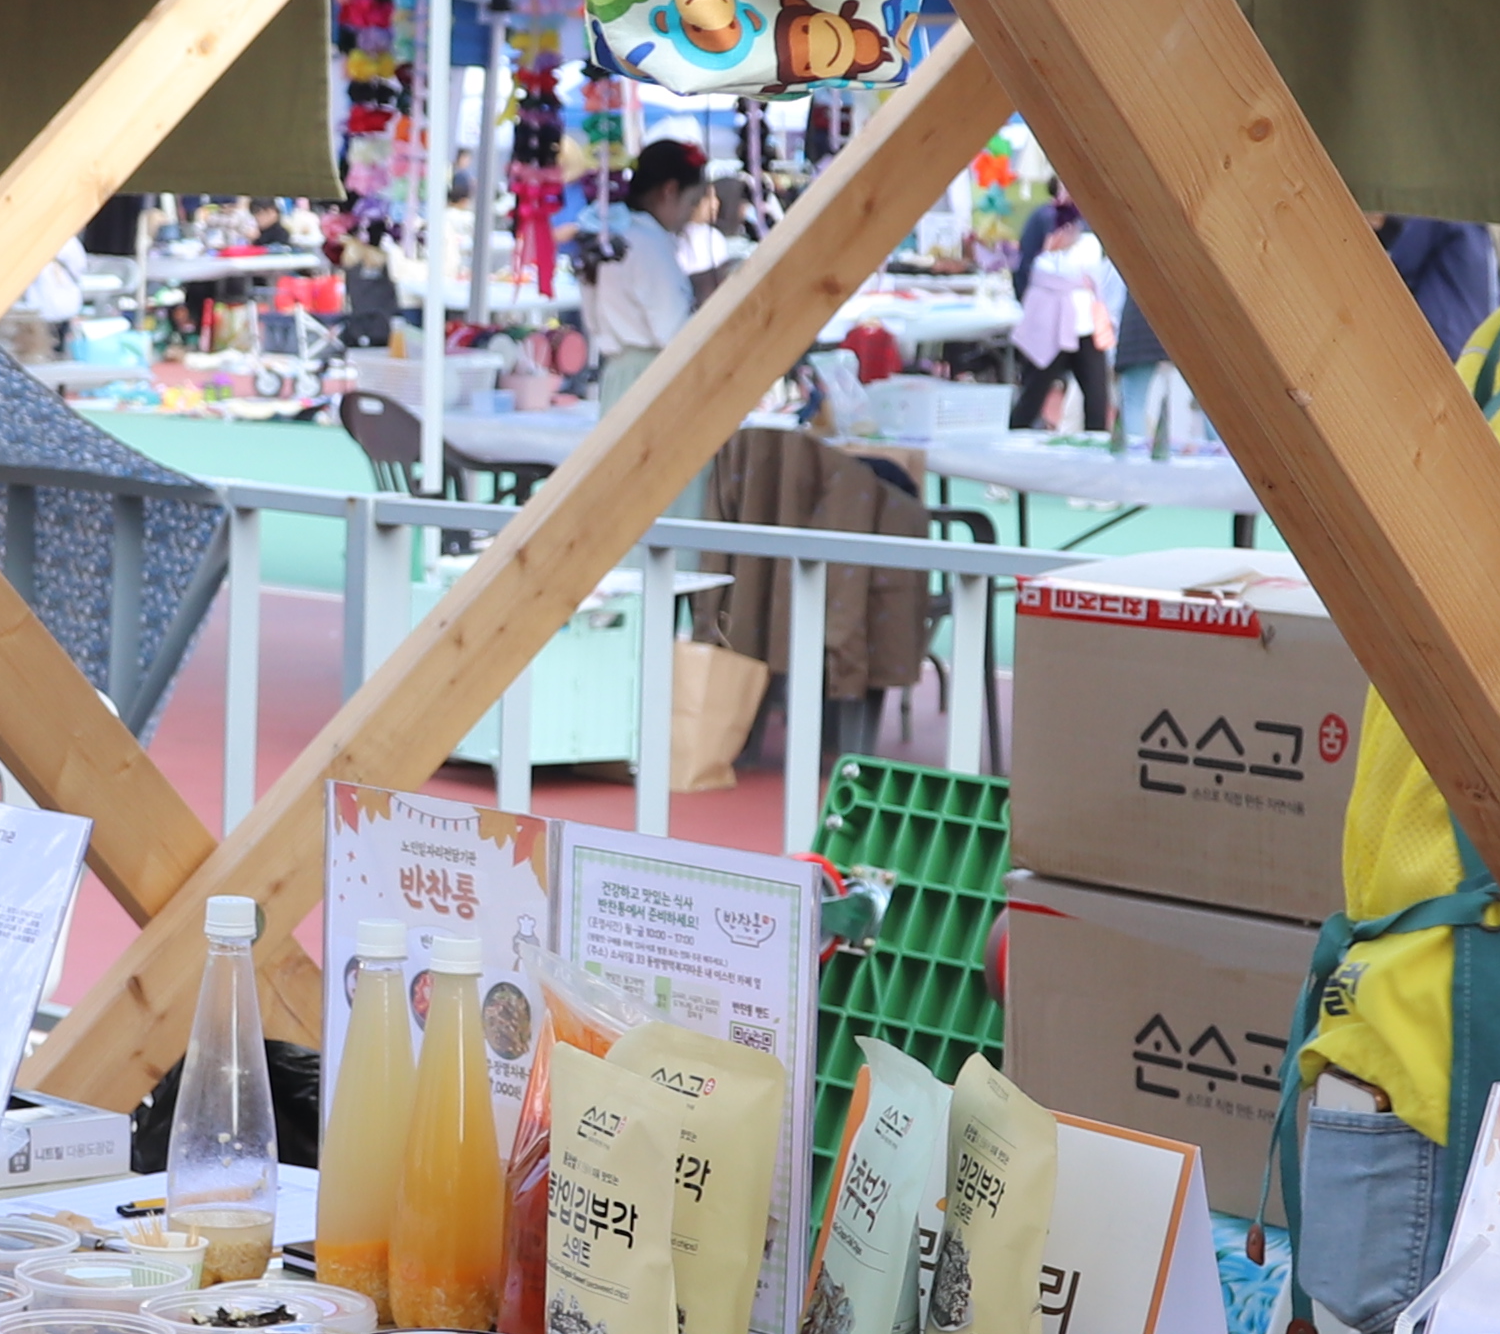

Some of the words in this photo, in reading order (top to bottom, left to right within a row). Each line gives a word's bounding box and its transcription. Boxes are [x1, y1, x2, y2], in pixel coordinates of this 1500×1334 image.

[401, 841, 478, 867] 노인일자리전담기관
[400, 863, 480, 921] 반찬통
[601, 880, 640, 900] 건강하고
[642, 887, 672, 906] 맛있는
[674, 894, 694, 911] 식사
[597, 897, 647, 920] 반찬통에서
[648, 906, 700, 931] 준비하세요!
[646, 927, 667, 941] 10:00
[675, 932, 695, 946] 17:00
[561, 1233, 592, 1269] 스위트
